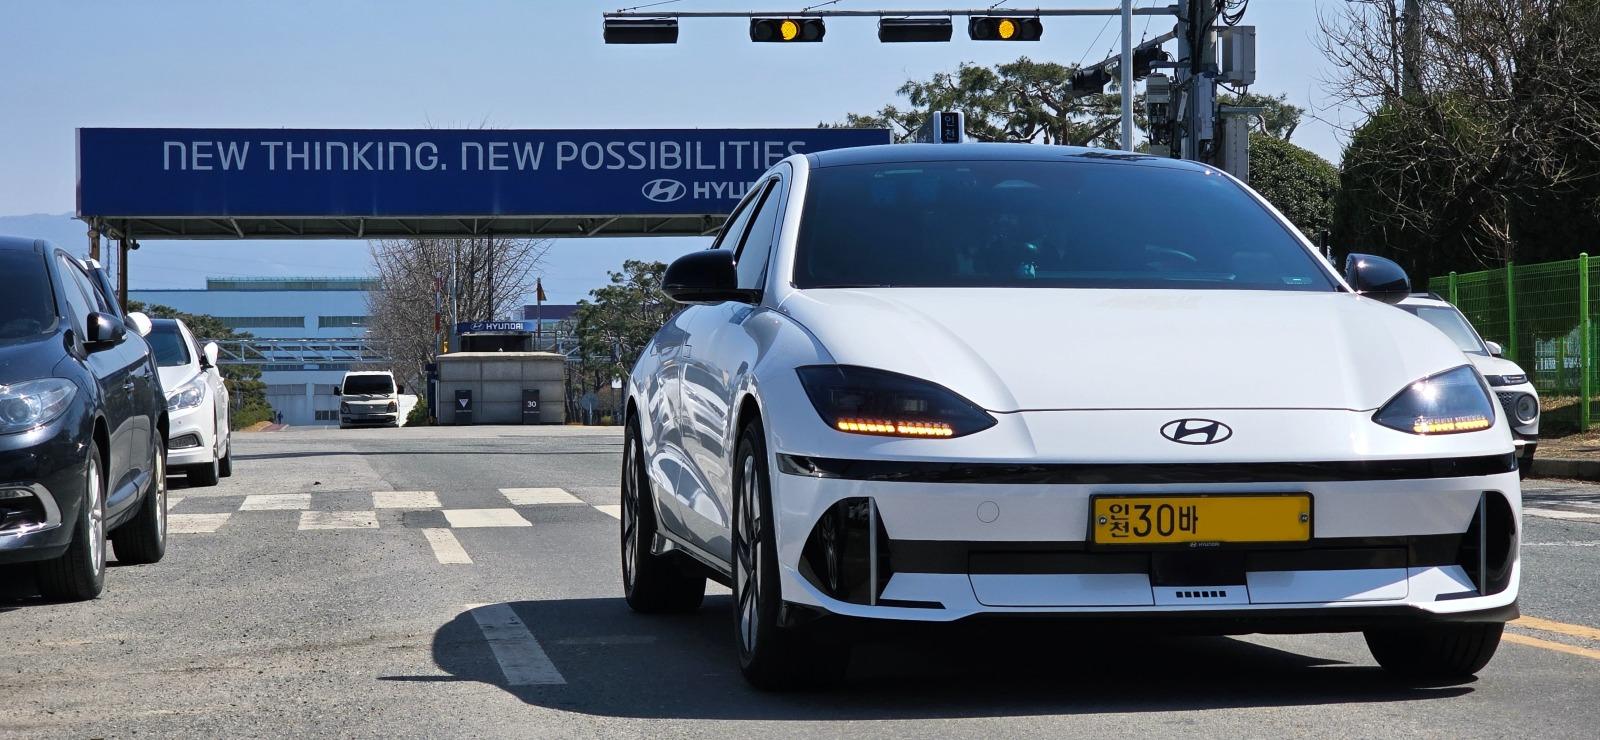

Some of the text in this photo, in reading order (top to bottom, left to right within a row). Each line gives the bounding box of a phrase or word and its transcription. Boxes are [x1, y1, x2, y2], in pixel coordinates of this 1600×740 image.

[944, 115, 956, 140] 인천
[163, 141, 250, 171] NEW
[260, 141, 447, 171] THINKING.
[461, 141, 545, 171] NEW
[693, 181, 761, 200] HYU
[486, 322, 524, 330] HYUNDAI
[527, 400, 537, 408] 30
[1109, 503, 1130, 538] 인천
